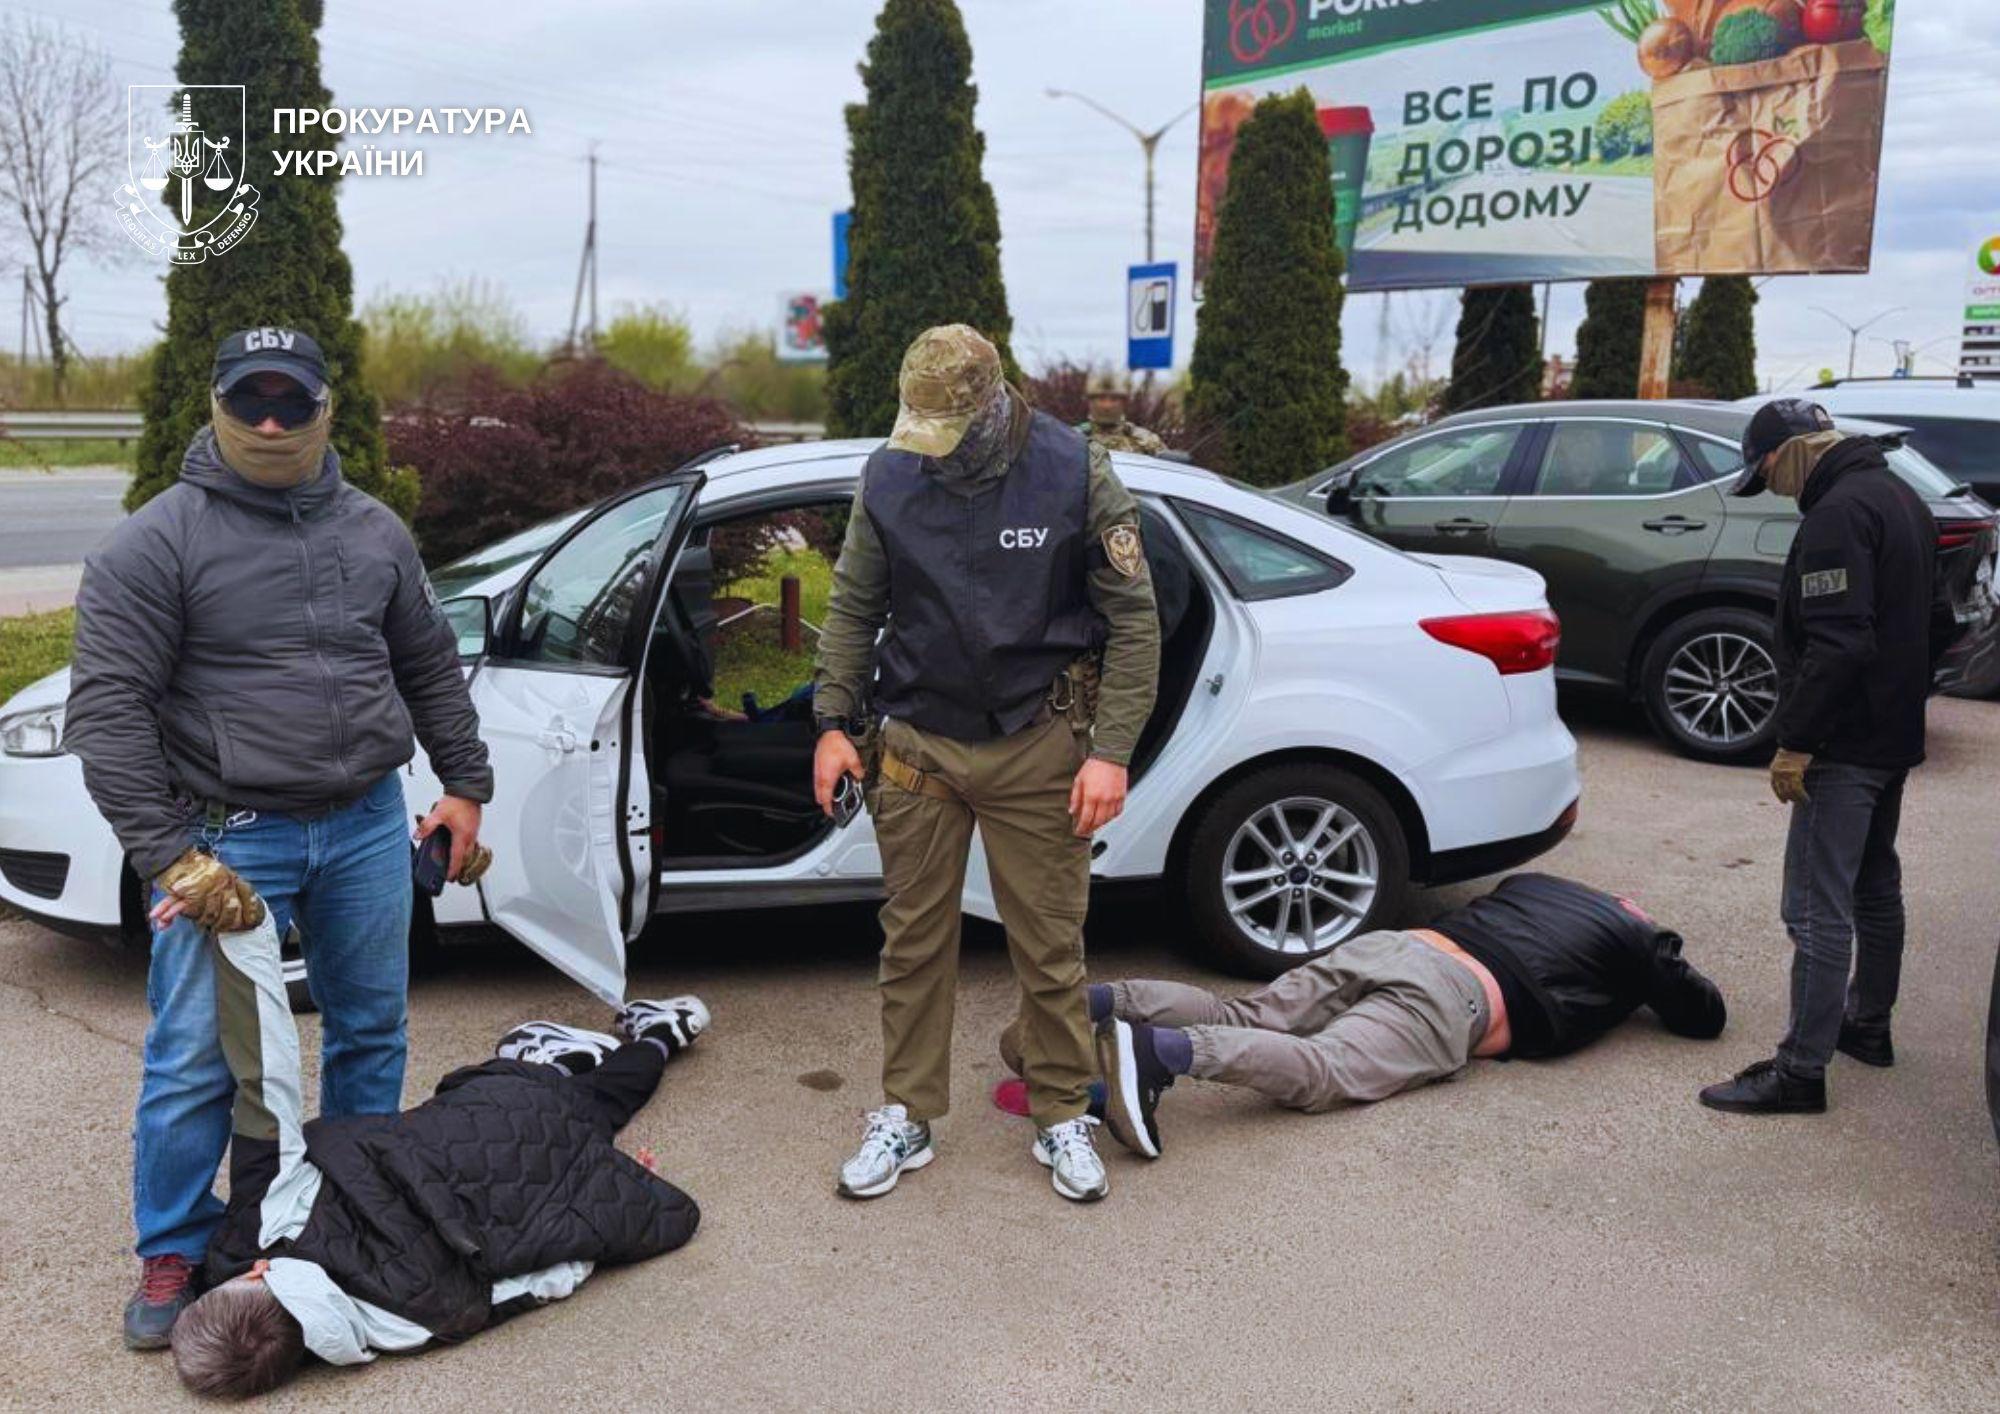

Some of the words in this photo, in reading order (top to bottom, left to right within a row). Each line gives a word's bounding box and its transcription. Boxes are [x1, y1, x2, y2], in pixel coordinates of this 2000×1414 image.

[1403, 82, 1494, 126] ВСЕ
[1523, 71, 1598, 114] ПО
[1397, 126, 1592, 192] ДОРОЗІ
[1392, 182, 1592, 234] ДОДОМУ
[245, 327, 295, 352] СБУ
[999, 527, 1049, 549] СБУ
